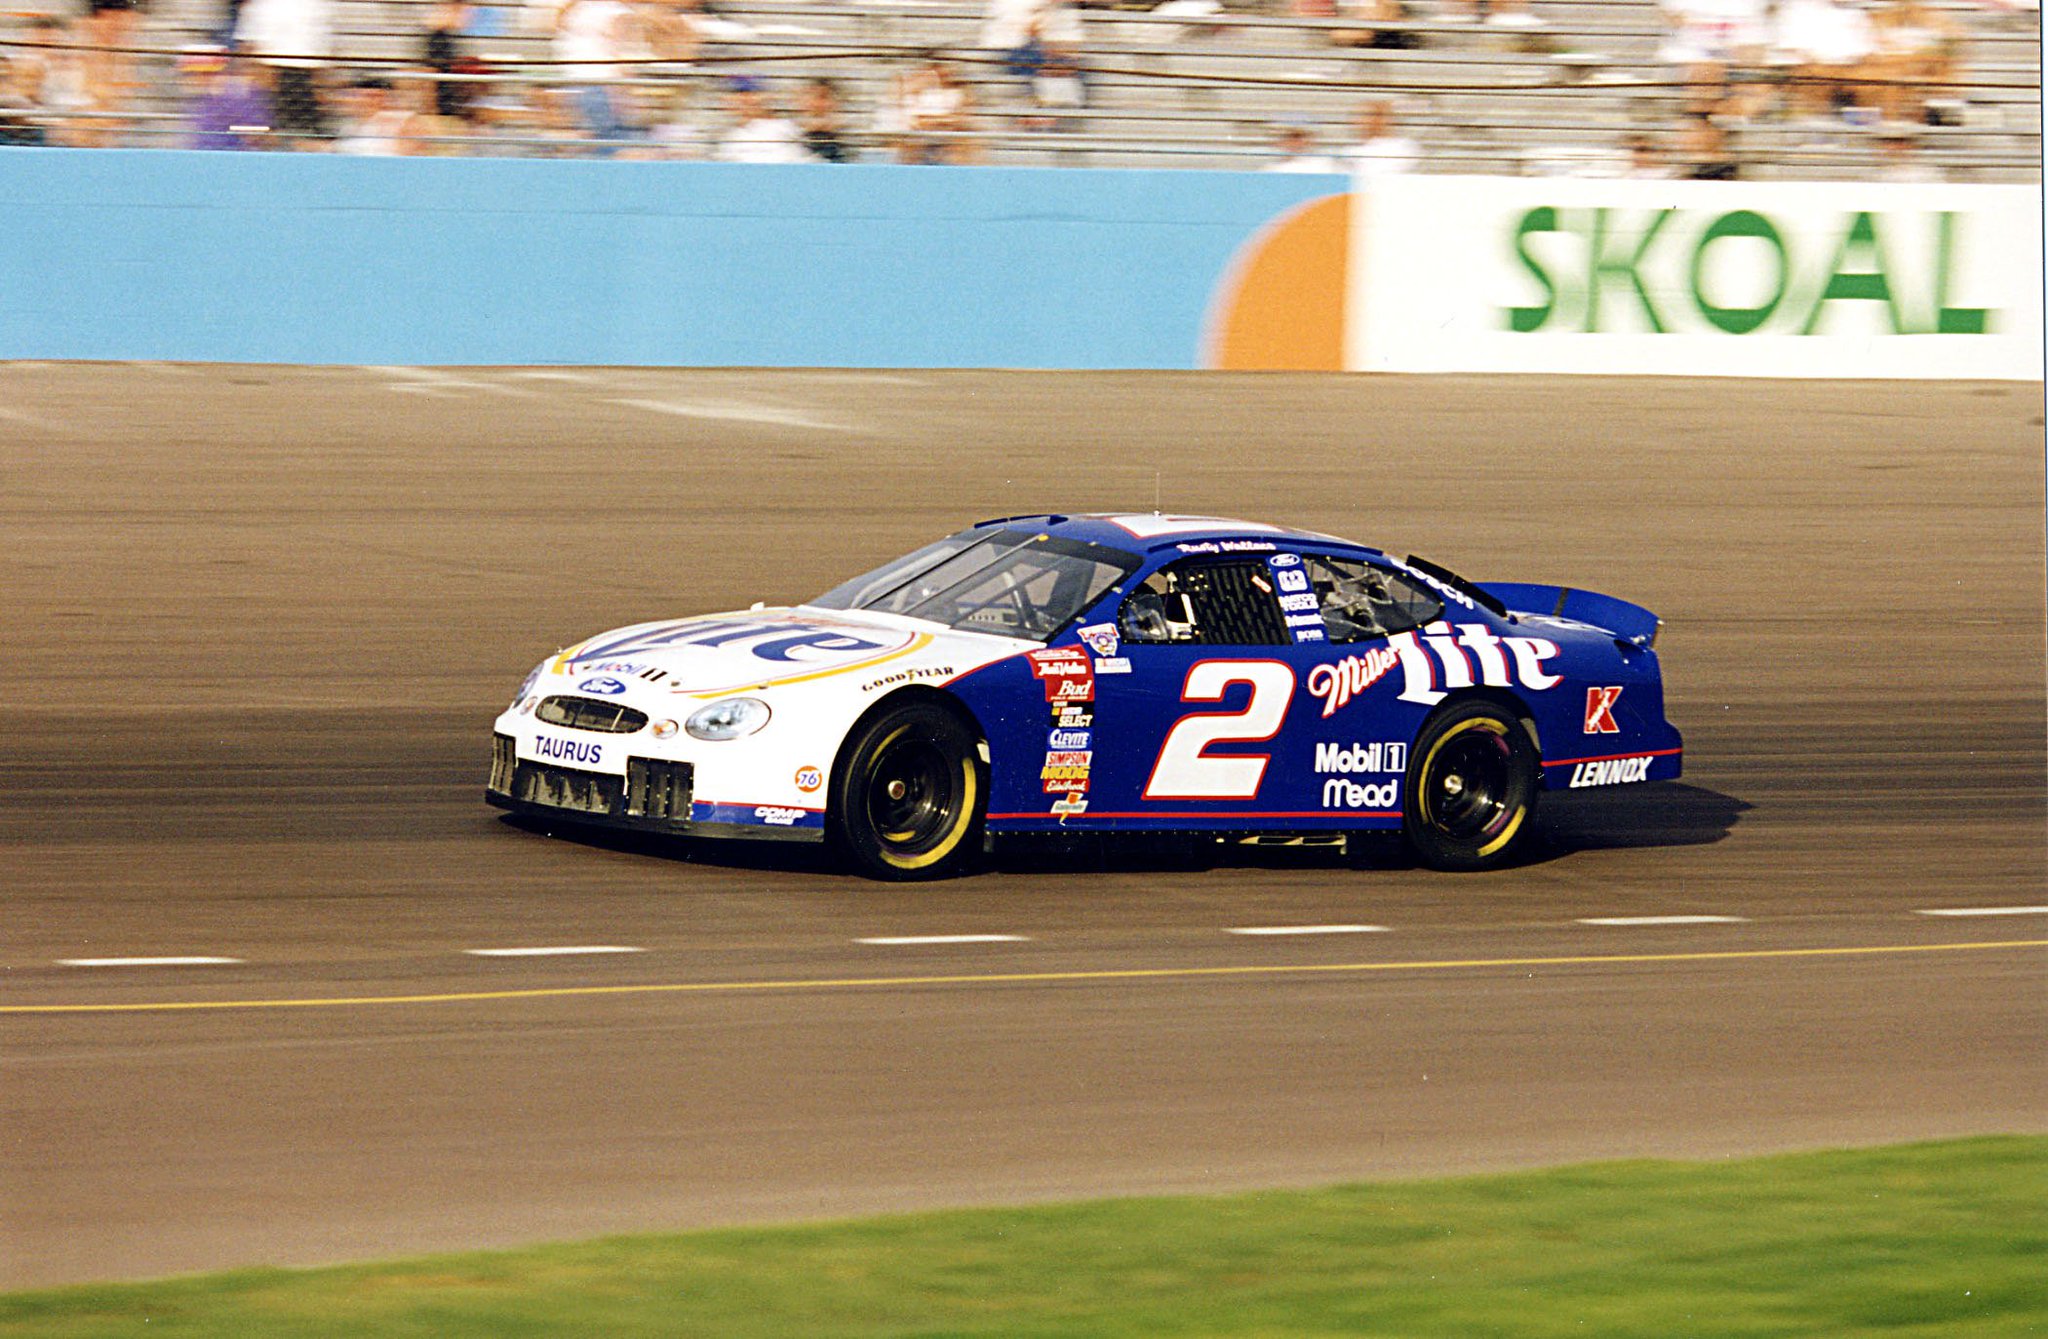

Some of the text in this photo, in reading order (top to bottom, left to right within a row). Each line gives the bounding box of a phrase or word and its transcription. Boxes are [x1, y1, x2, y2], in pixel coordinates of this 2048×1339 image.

[1500, 206, 2002, 335] SKOAL
[1307, 621, 1564, 719] Miller Lite
[1057, 680, 1092, 695] Bud
[1058, 715, 1093, 727] SELECT
[1142, 659, 1297, 799] 2
[535, 735, 602, 763] TAURUS
[1048, 753, 1089, 765] SIMPSON
[1315, 743, 1403, 773] Mobil 1
[799, 772, 818, 786] 76
[1040, 766, 1091, 779] MOOG
[1569, 756, 1654, 788] LENNOX
[1323, 779, 1398, 808] Mead
[755, 806, 807, 820] COMP
